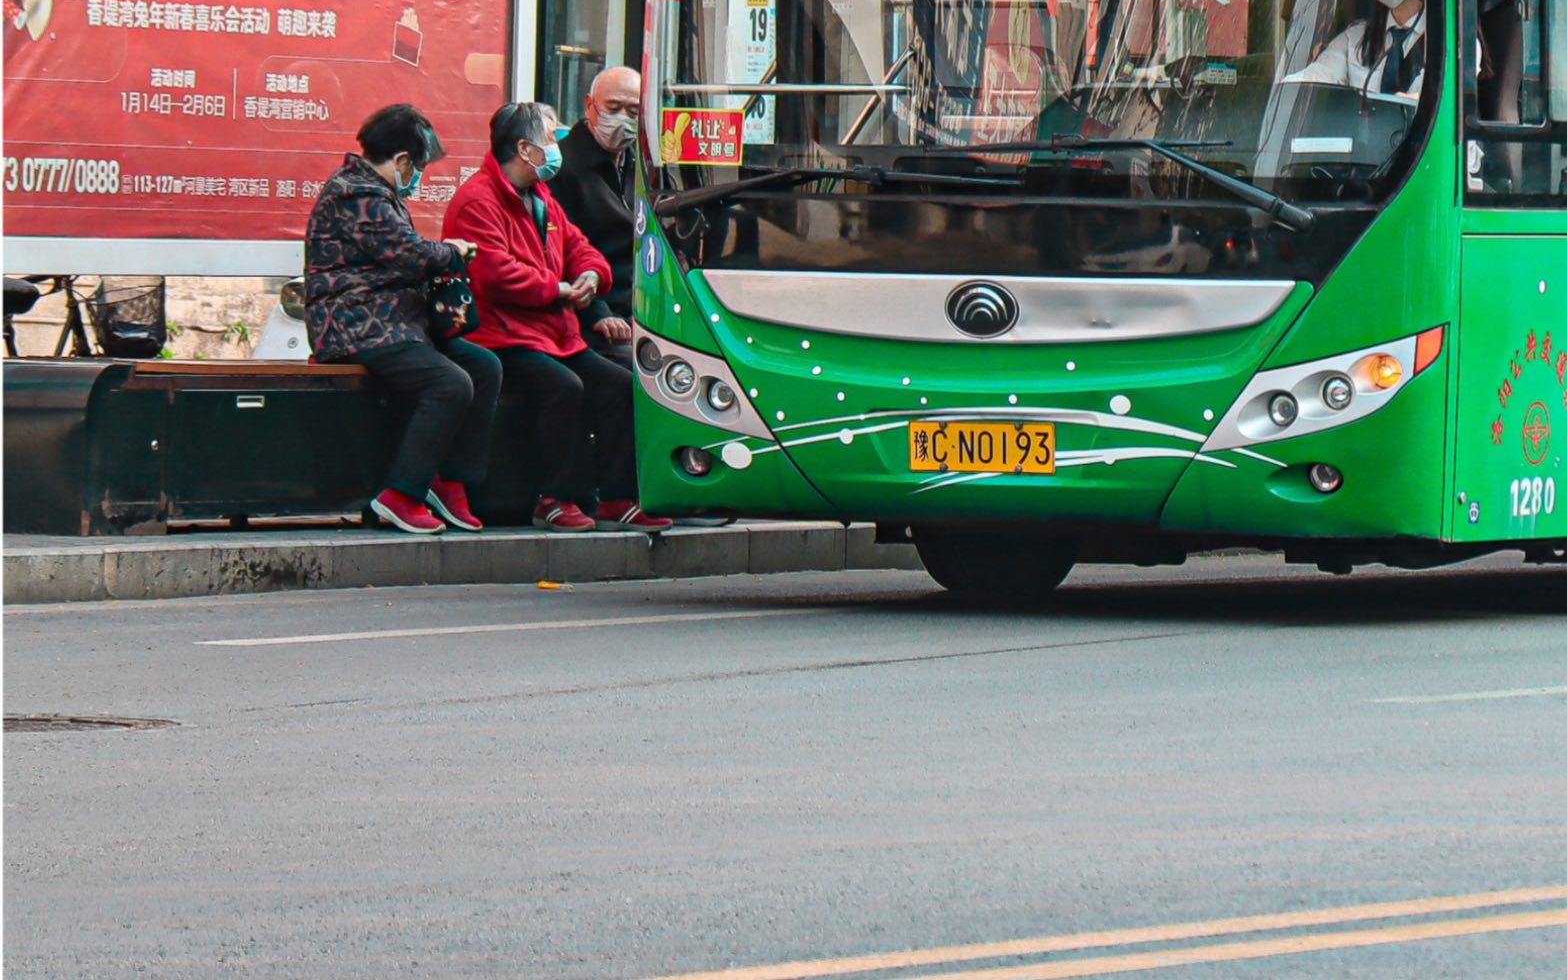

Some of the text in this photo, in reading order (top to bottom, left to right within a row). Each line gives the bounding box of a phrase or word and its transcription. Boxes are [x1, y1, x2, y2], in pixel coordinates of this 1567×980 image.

[277, 8, 337, 38] 萌趣来袭
[749, 8, 767, 41] 19
[150, 67, 196, 89] 活动时间
[265, 73, 310, 94] 活动地点
[243, 96, 330, 121] 香堤湾营销中心
[691, 119, 722, 139] 礼让
[698, 142, 735, 157] 文明号
[22, 158, 120, 195] 0777/0888
[1511, 477, 1555, 516] 1280
